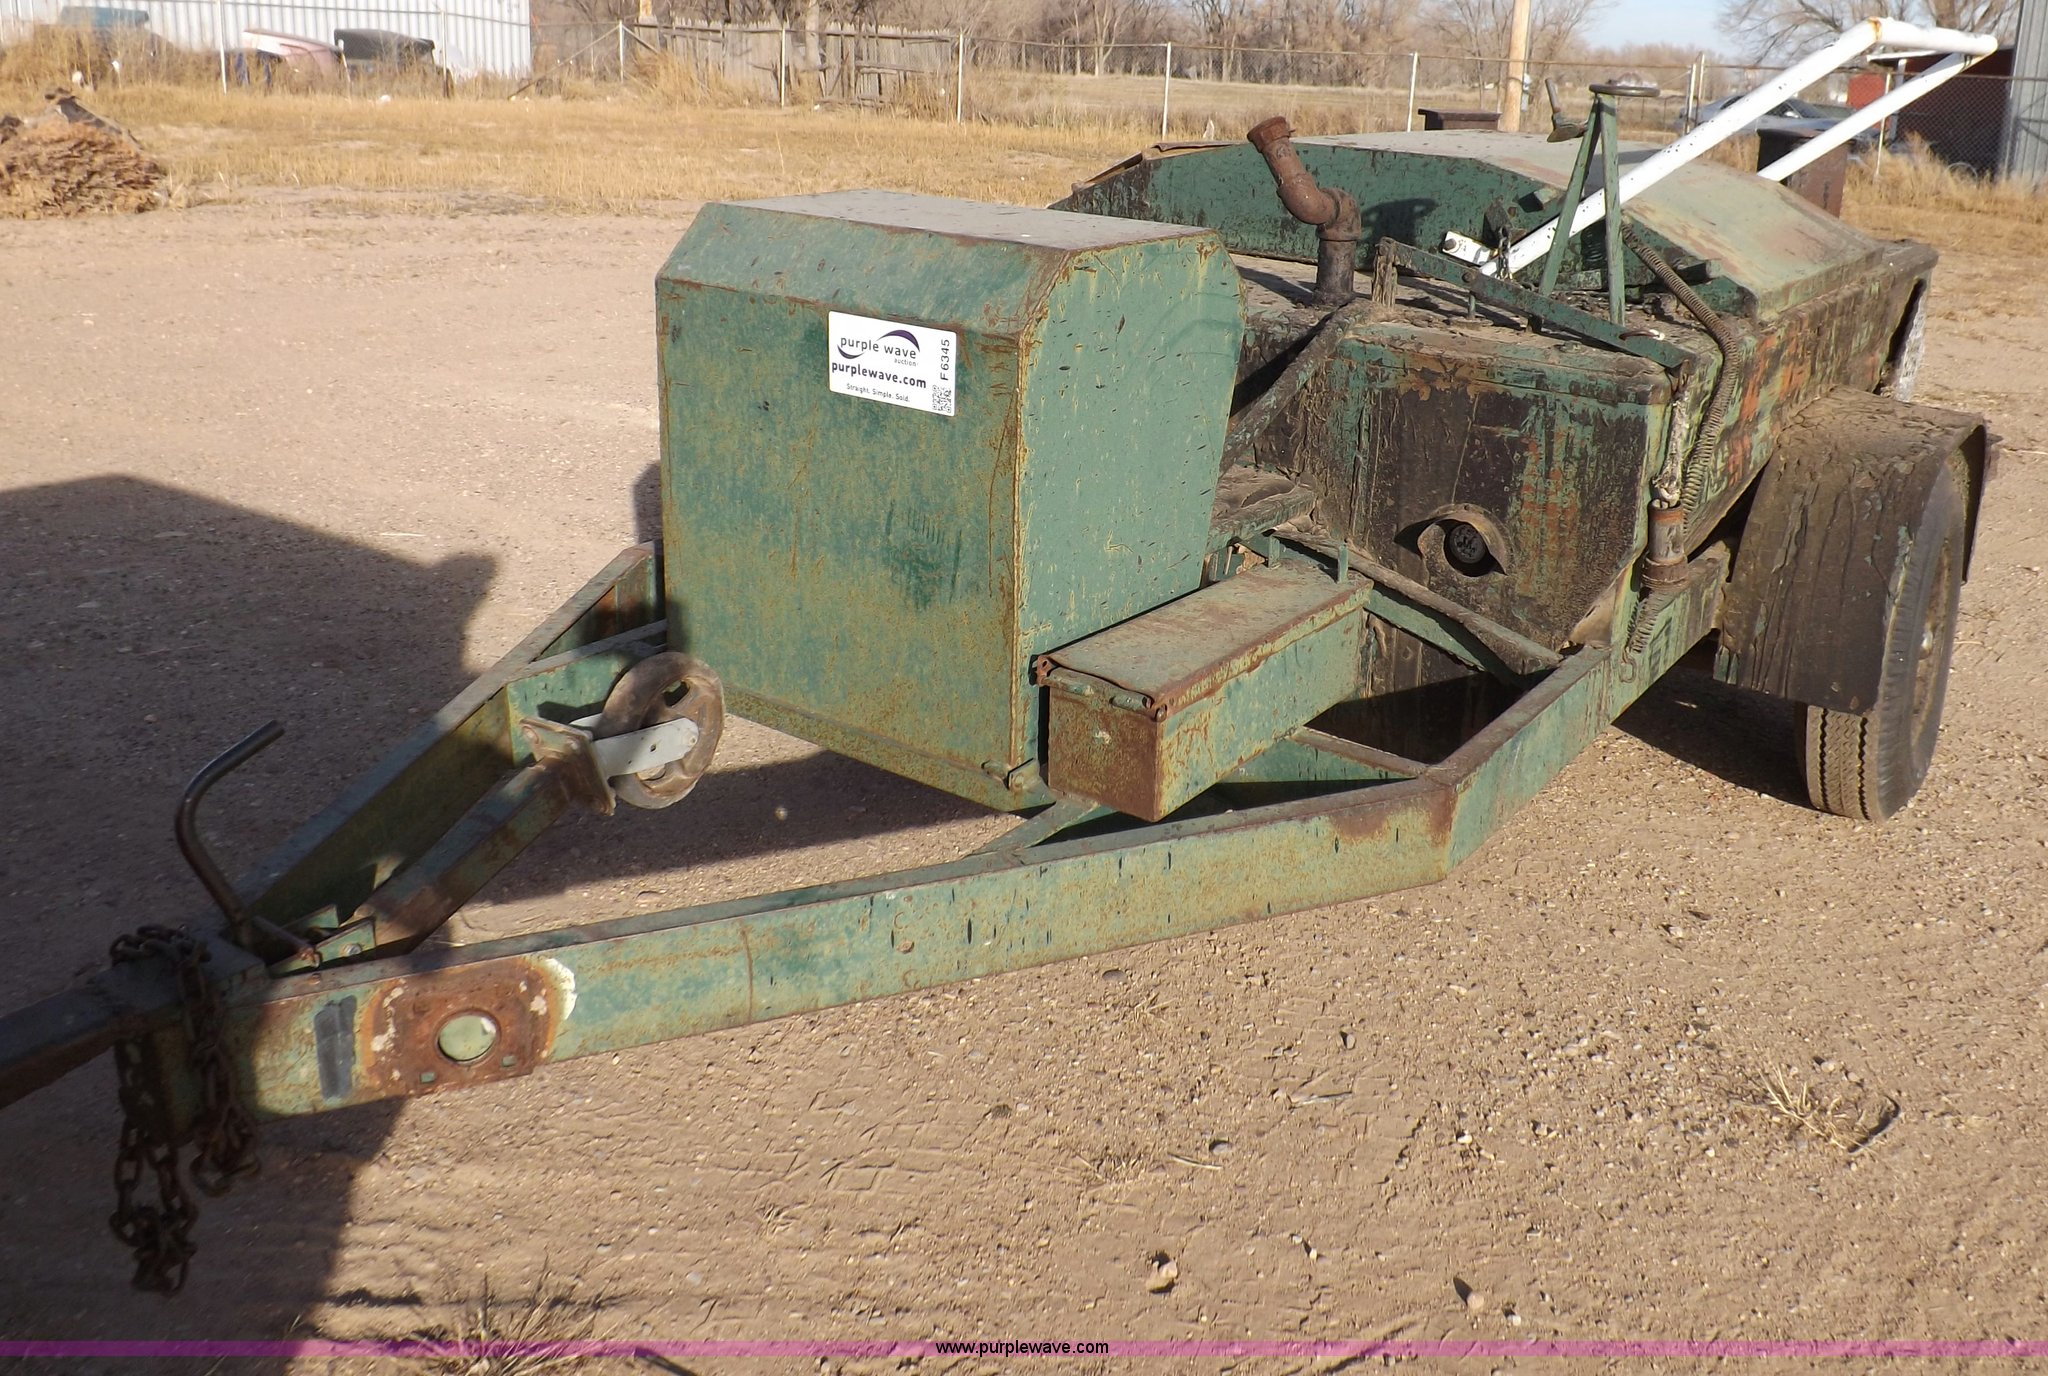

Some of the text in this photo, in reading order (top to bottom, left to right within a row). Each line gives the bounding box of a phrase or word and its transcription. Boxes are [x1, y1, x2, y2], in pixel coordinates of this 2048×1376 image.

[840, 337, 917, 359] purple wave
[894, 358, 917, 367] auction
[940, 339, 950, 381] F6345
[832, 362, 927, 389] purplewave.com
[846, 383, 870, 394] Straight.
[872, 389, 894, 400] Simple.
